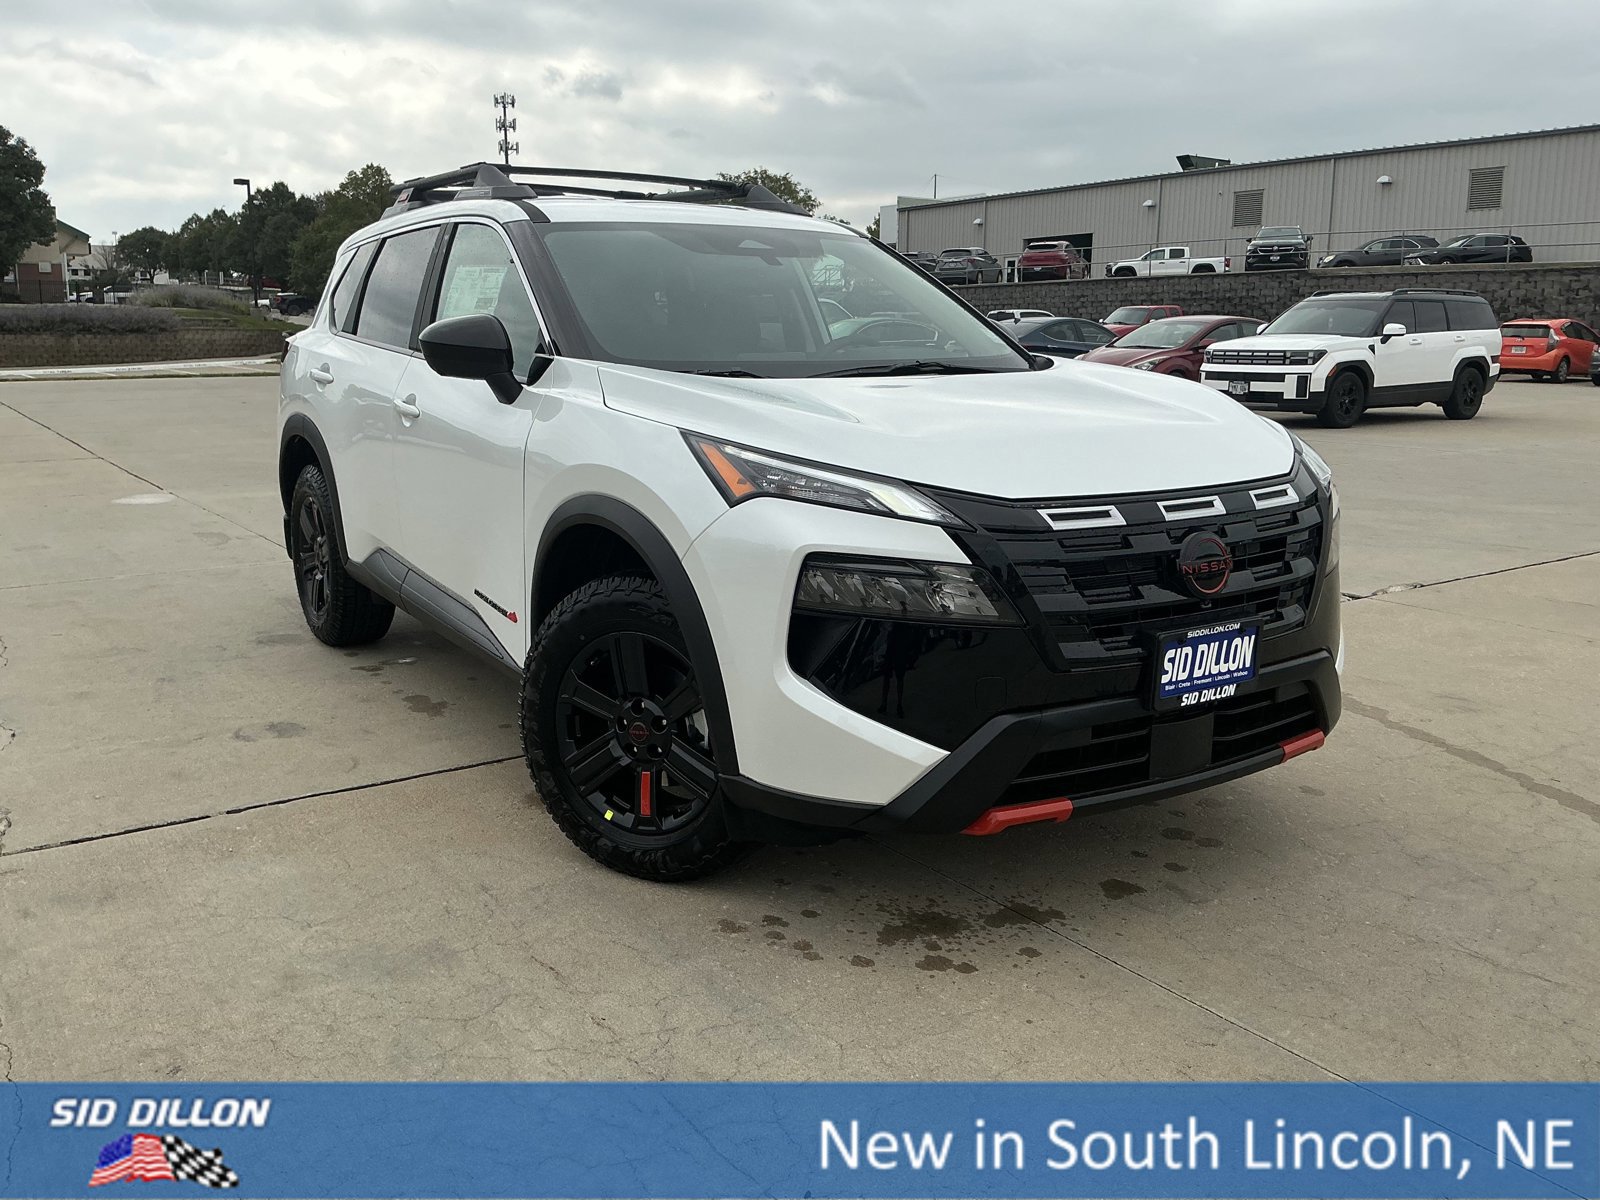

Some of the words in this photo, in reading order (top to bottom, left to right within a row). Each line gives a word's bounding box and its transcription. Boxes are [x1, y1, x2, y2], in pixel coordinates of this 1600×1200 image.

[1182, 559, 1233, 575] NISSAN
[1187, 622, 1240, 638] SIDDILLON.COM
[1161, 646, 1192, 684] SID
[1193, 635, 1255, 678] DILLON
[1180, 692, 1198, 706] SID
[1200, 684, 1236, 702] DILLON
